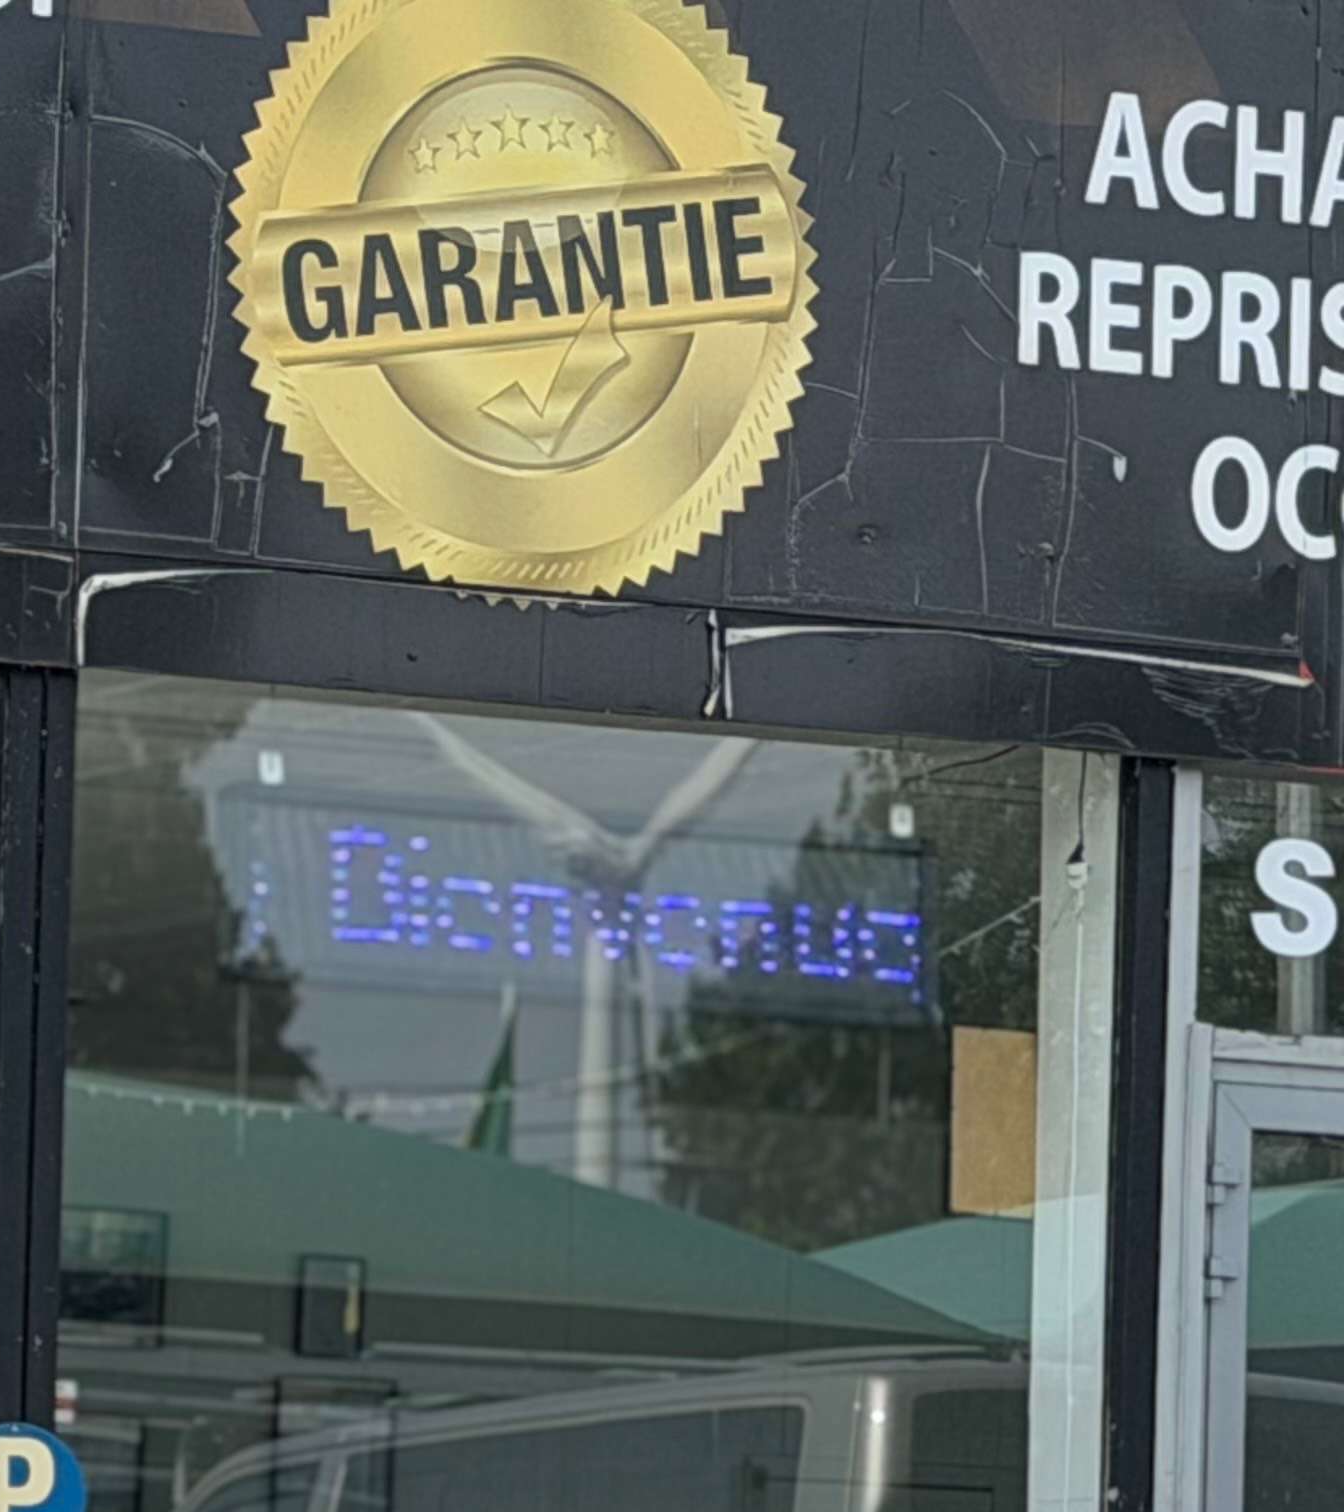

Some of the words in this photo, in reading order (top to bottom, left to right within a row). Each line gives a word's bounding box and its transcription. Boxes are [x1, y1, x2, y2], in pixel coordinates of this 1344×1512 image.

[281, 197, 772, 343] GARANTIE
[1191, 435, 1344, 560] OC
[1249, 837, 1338, 958] S
